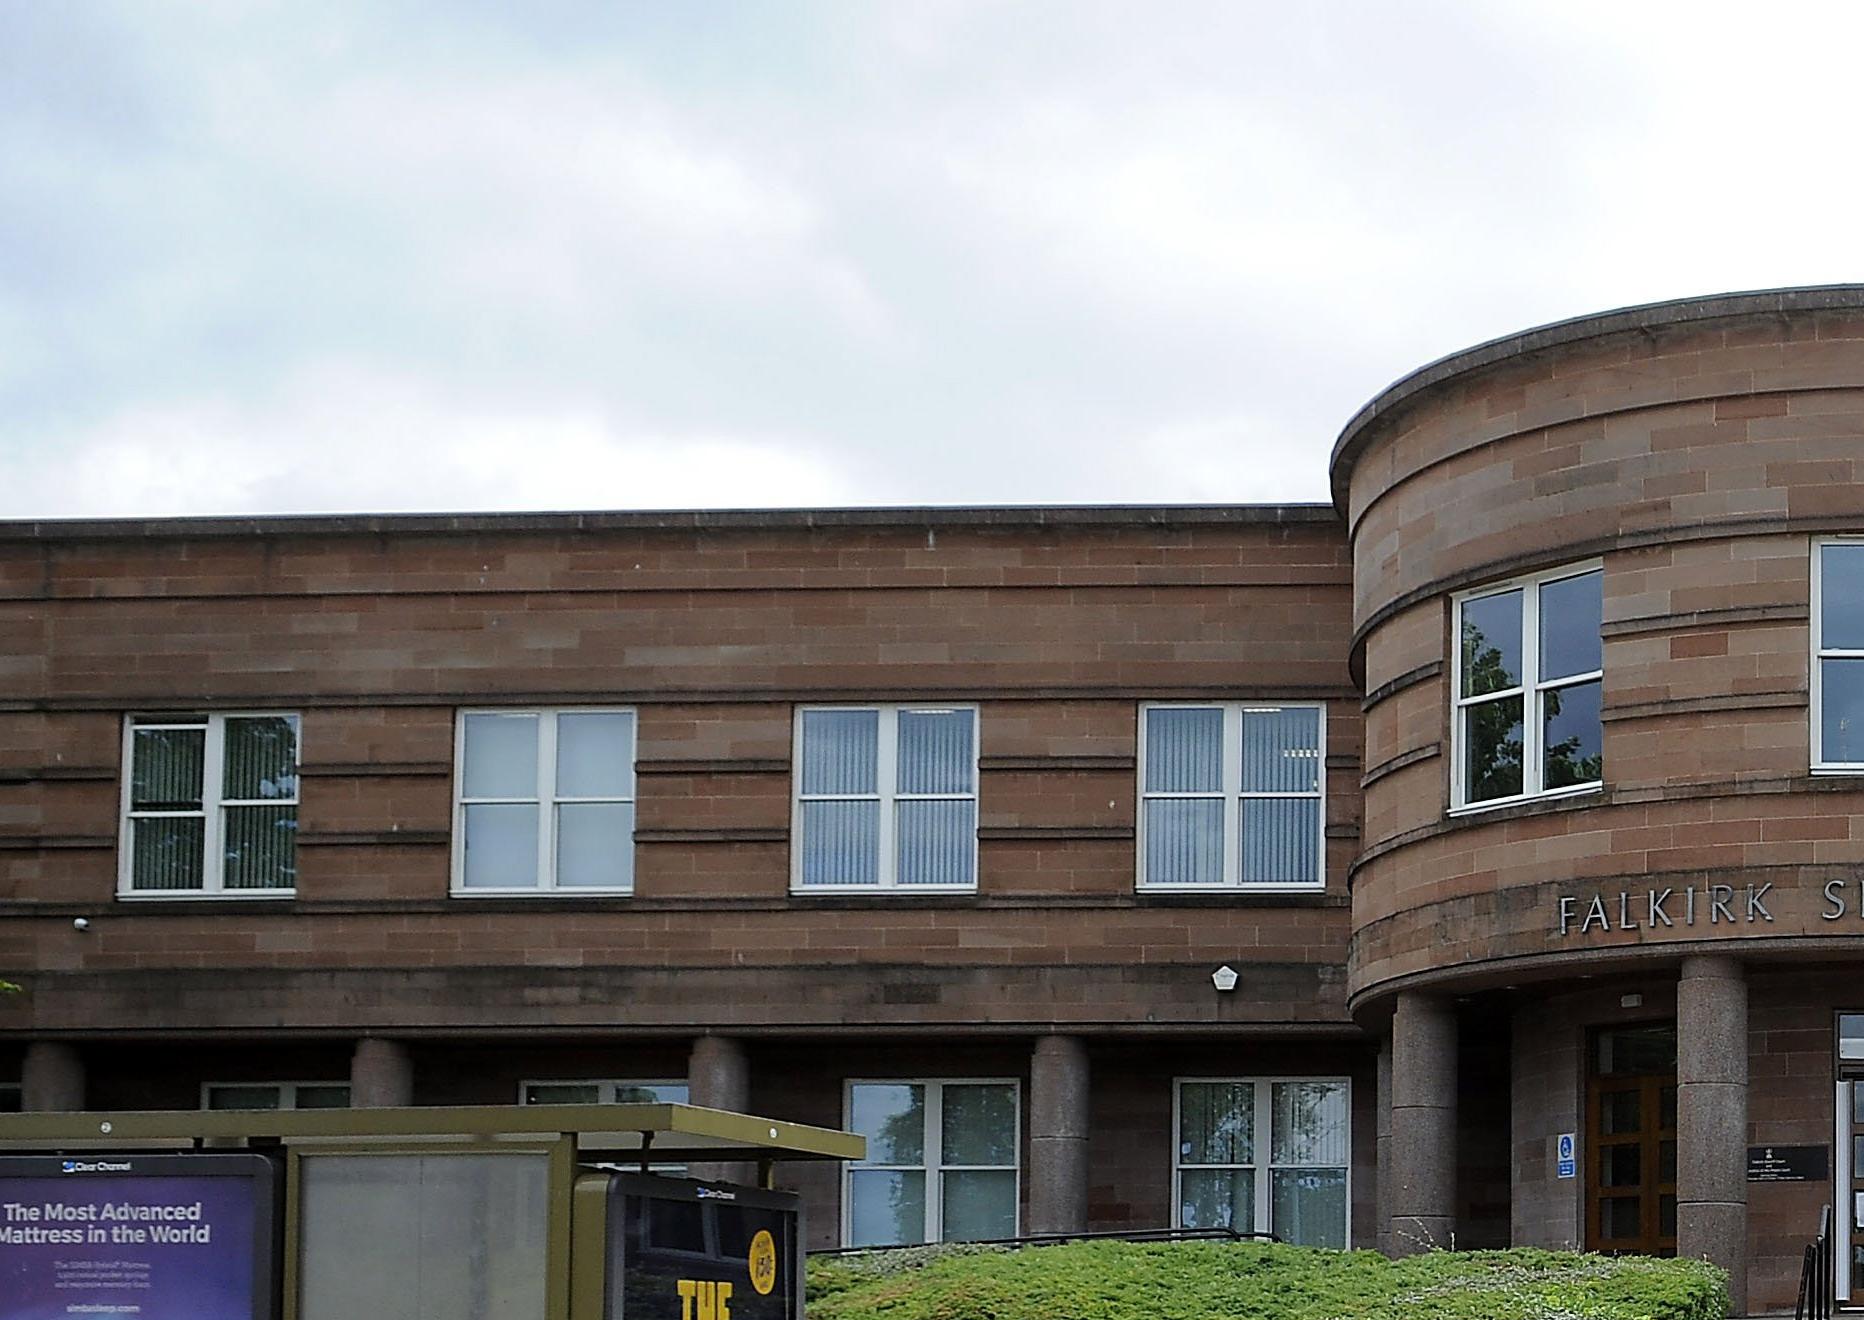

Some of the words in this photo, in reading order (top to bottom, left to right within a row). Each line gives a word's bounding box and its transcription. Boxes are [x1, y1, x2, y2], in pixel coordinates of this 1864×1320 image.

[1560, 882, 1773, 935] FALKIRK
[4, 1203, 41, 1221] The
[44, 1203, 97, 1221] Most
[100, 1202, 202, 1221] Advanced
[0, 1225, 83, 1244] Mattress
[87, 1224, 107, 1243] in
[112, 1225, 146, 1243] the
[150, 1224, 211, 1243] World
